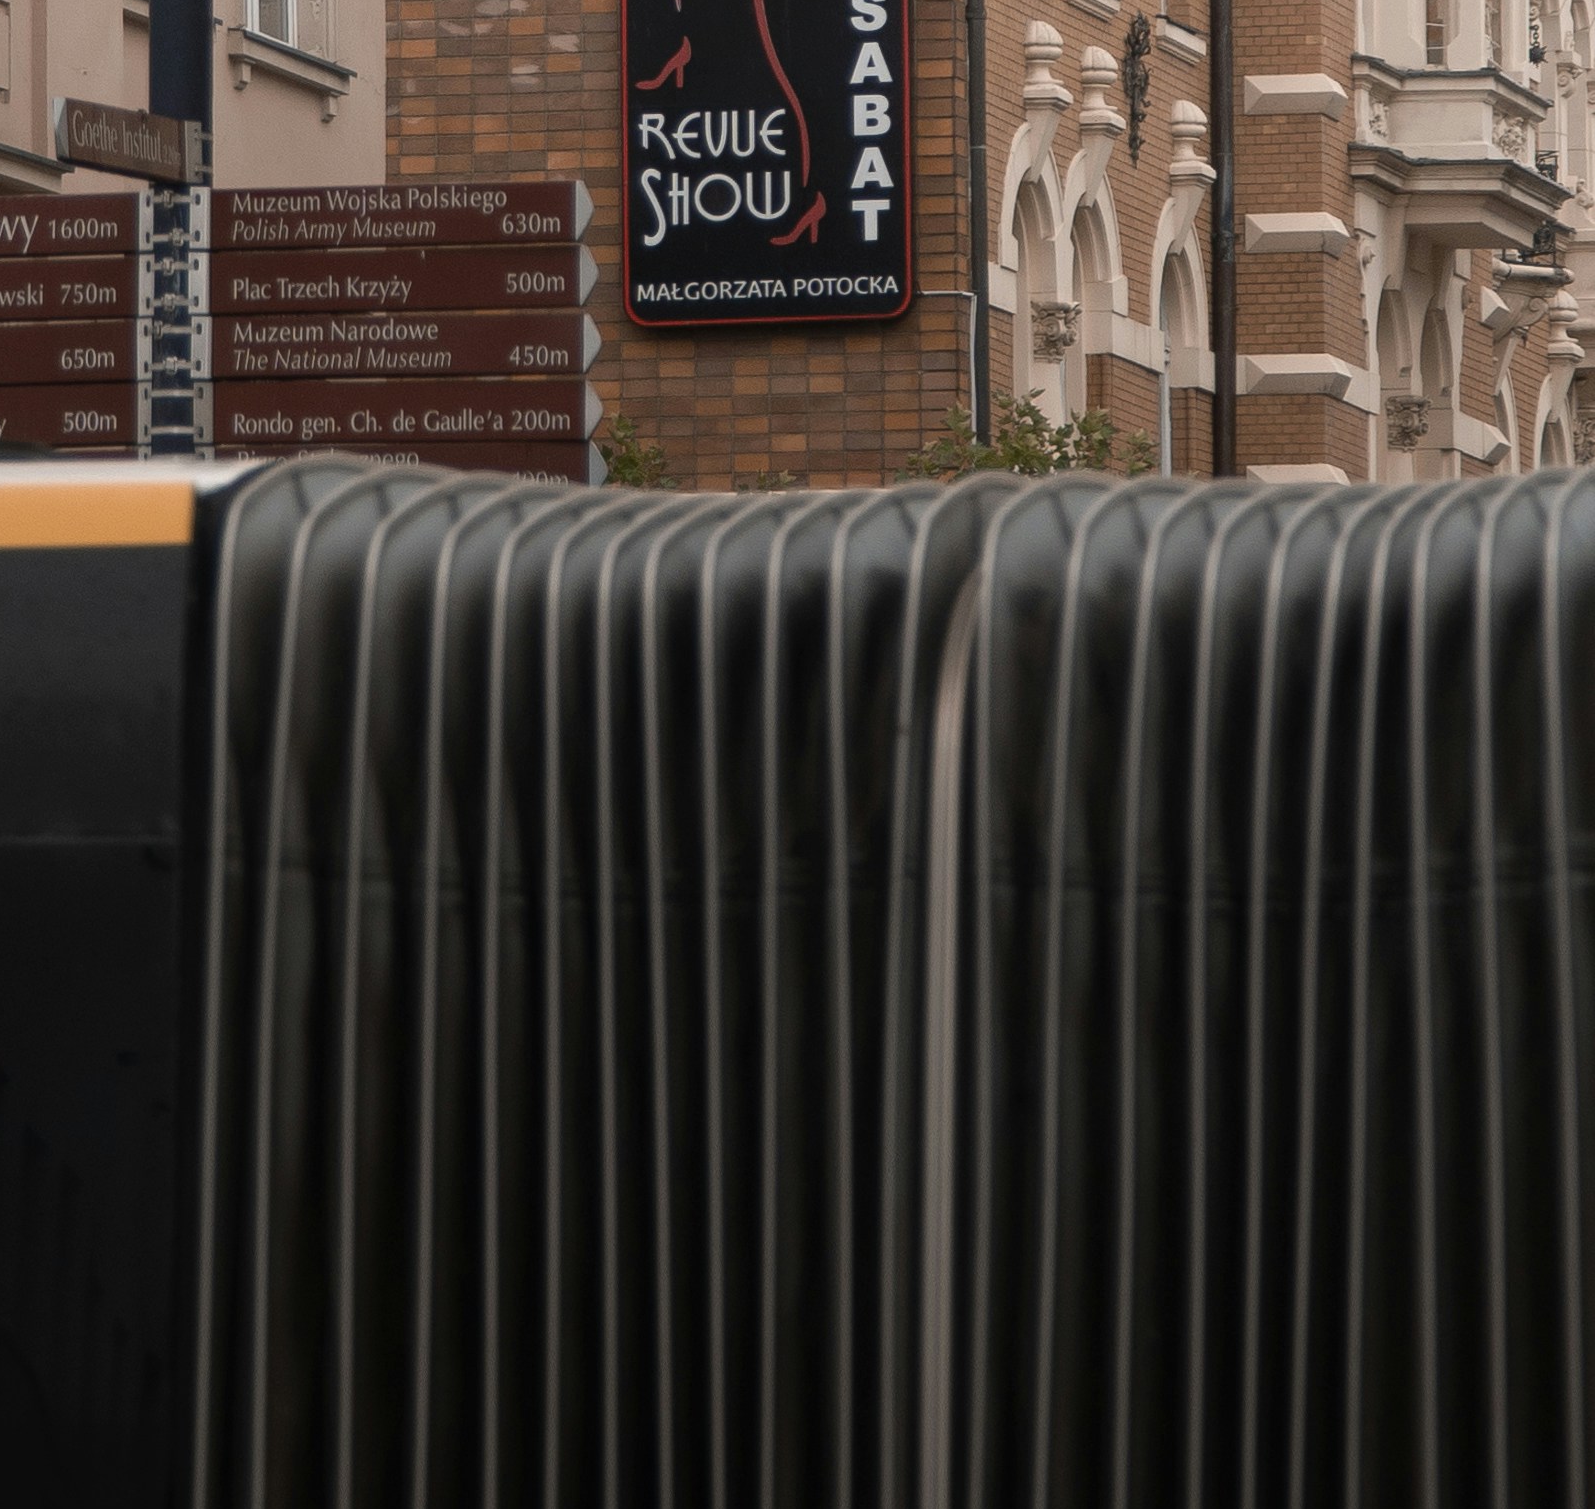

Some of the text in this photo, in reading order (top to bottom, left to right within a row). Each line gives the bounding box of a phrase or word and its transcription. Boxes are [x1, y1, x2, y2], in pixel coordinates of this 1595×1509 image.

[72, 109, 119, 153] Goethe
[122, 119, 163, 163] Institut
[638, 108, 786, 160] REVUE
[232, 185, 508, 218] Muzeum Wojska Polskiego
[640, 167, 791, 247] SHOW
[48, 217, 119, 240] 1600m
[231, 217, 437, 246] Polish Army Museum
[502, 212, 561, 235] 630m
[60, 282, 118, 305] 750m
[232, 272, 565, 305] Plac Trzech Krzyży 500m
[636, 275, 900, 303] MAŁGORZATA POTOCKA
[233, 318, 439, 344] Muzeum Narodowe
[60, 348, 115, 370] 650m
[233, 346, 453, 371] The National Museum
[509, 344, 569, 367] 450m
[62, 410, 118, 433] 500m
[233, 408, 571, 440] Rondo gen. Ch. de Gaulle'a 200m
